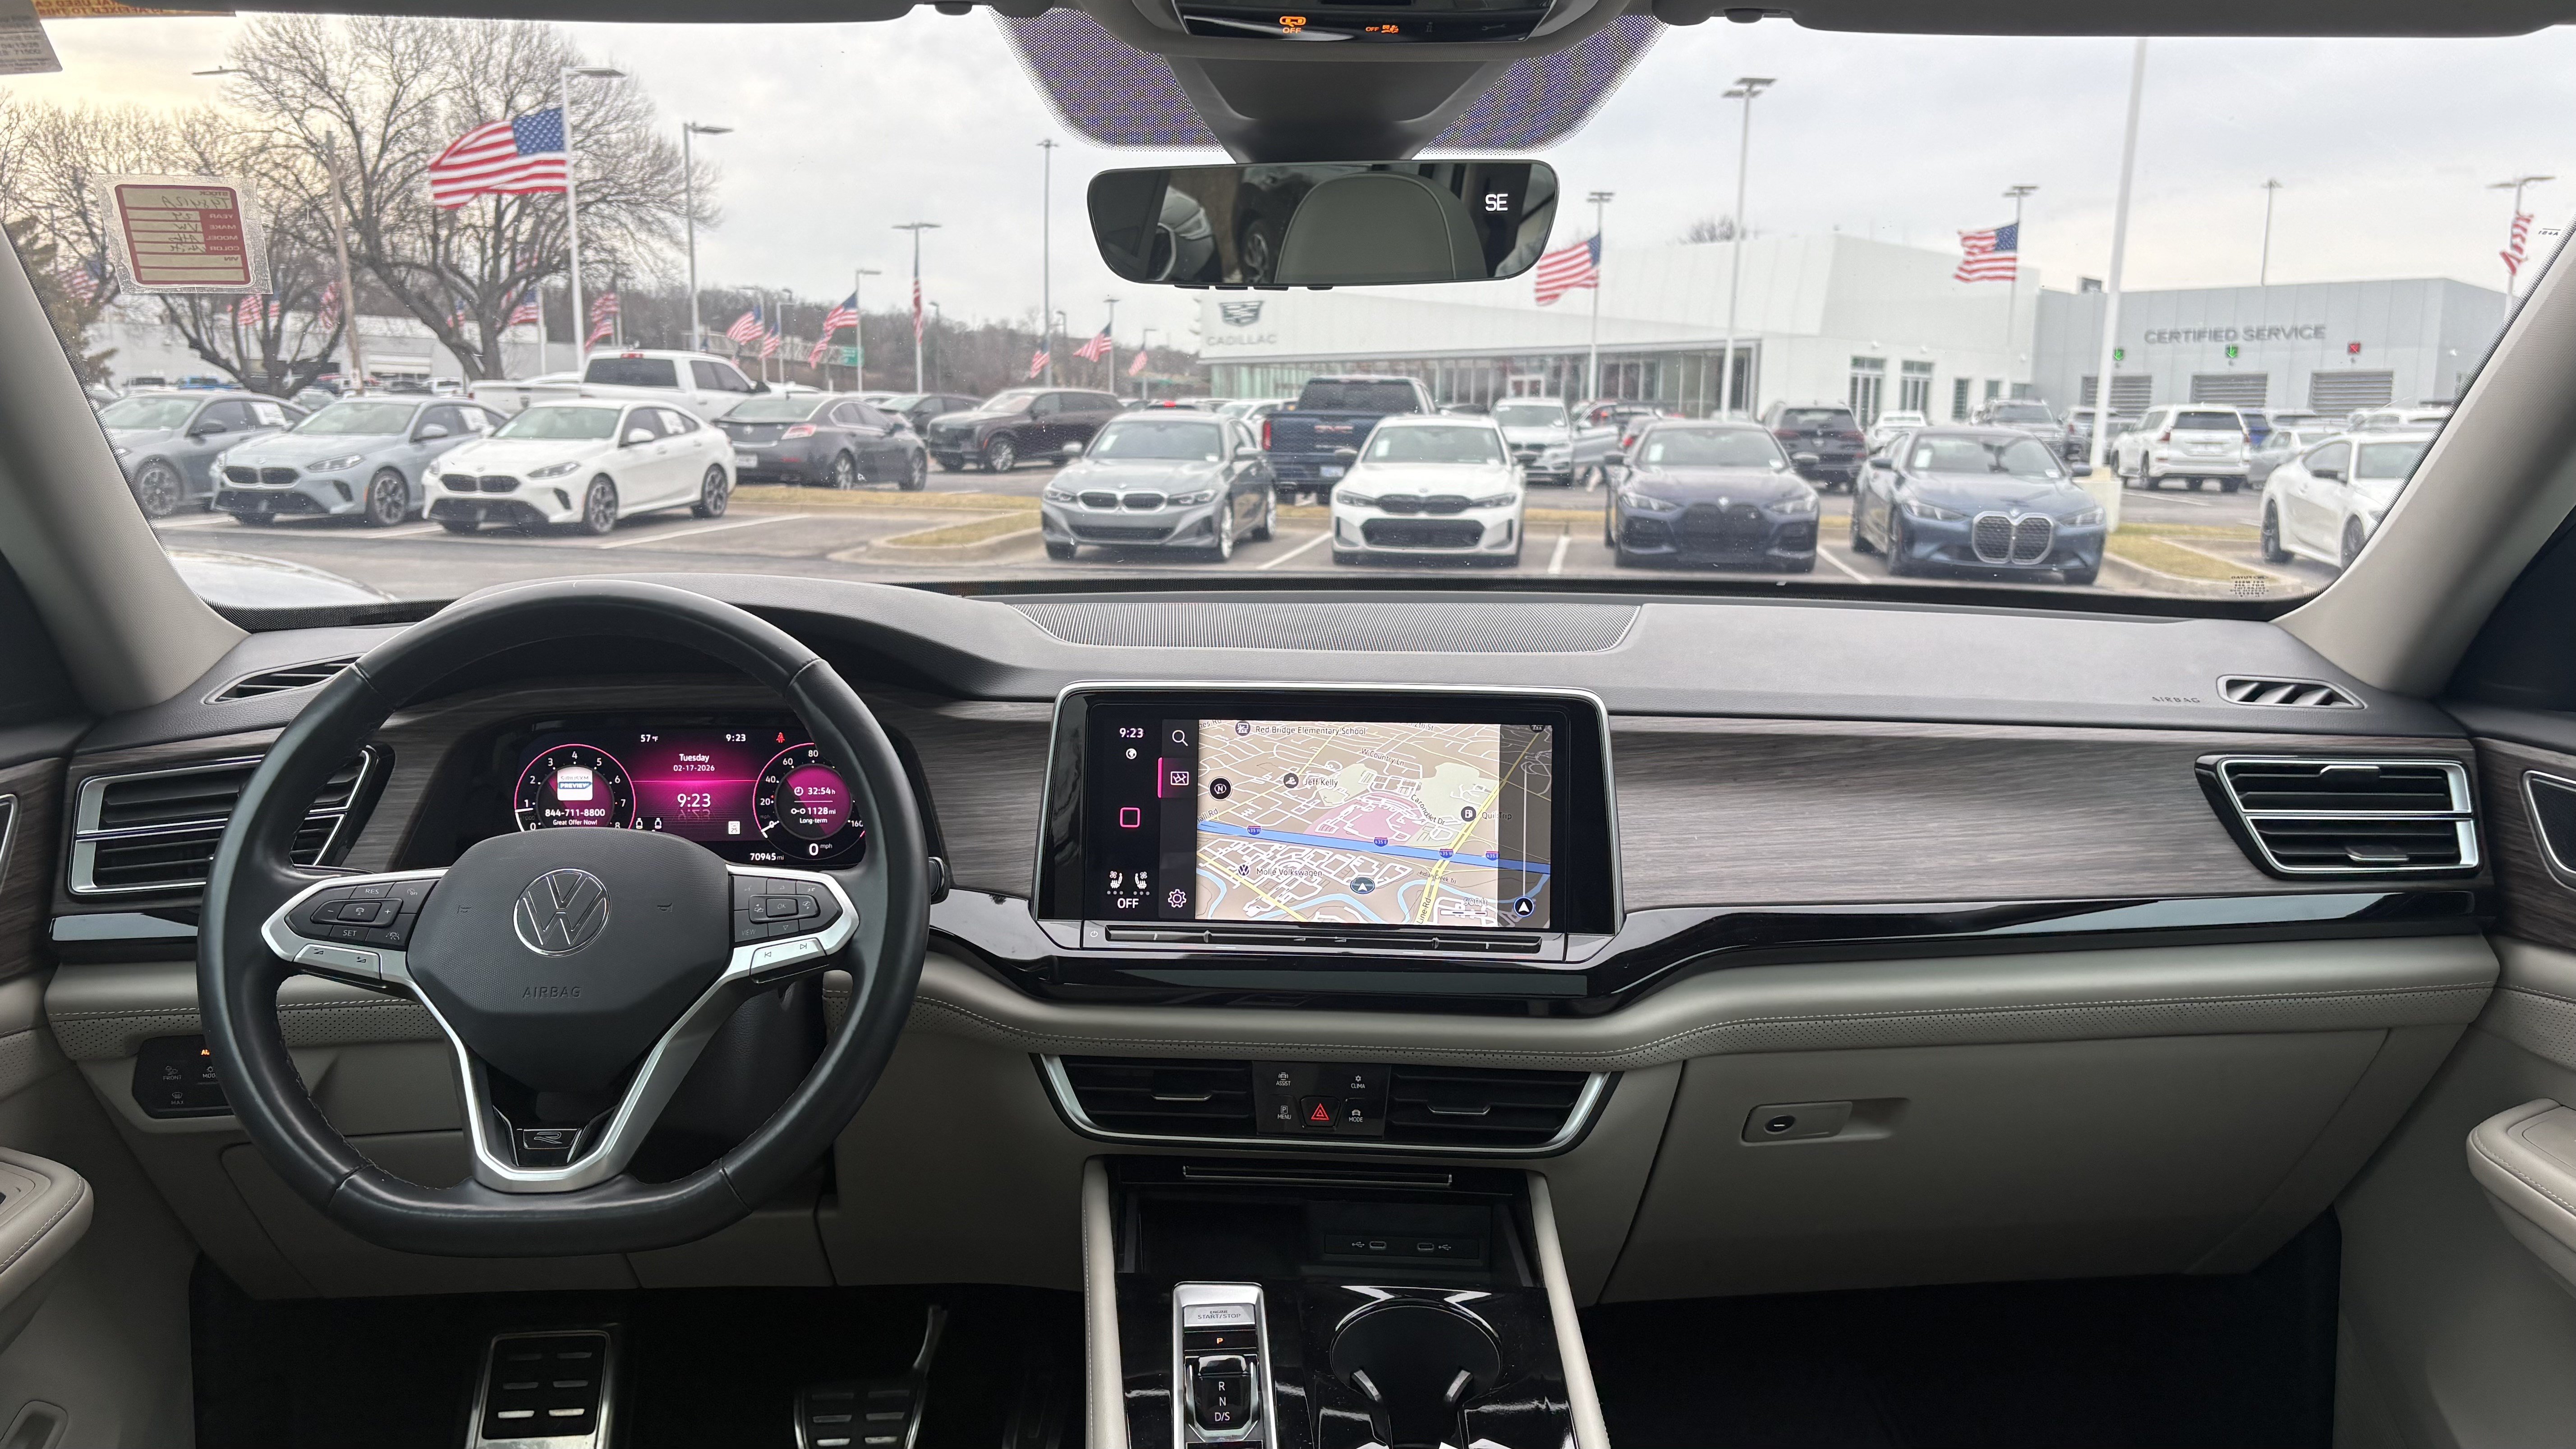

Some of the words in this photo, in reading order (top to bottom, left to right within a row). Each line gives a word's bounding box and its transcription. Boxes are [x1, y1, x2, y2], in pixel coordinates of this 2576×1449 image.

[1485, 193, 1508, 211] SE
[2144, 327, 2238, 345] CERTIFIED
[2242, 324, 2326, 342] SERVICE
[1206, 334, 1277, 346] CADILLAC
[1119, 728, 1144, 738] 9:23
[1272, 726, 1295, 735] Bridge
[1298, 727, 1339, 736] Elementary
[726, 734, 746, 742] 9:23
[548, 758, 553, 766] 3
[679, 754, 710, 762] Tuesday
[1370, 750, 1395, 764] Country
[1320, 779, 1338, 787] Kelly
[677, 793, 711, 808] 9:23
[760, 798, 770, 806] 20
[1208, 808, 1218, 817] Rd
[530, 823, 536, 831] 0
[809, 843, 819, 856] 0
[1279, 869, 1323, 878] Volkswagen
[1435, 874, 1449, 883] Creek
[1117, 898, 1139, 909] OFF
[1416, 908, 1428, 924] Line
[1422, 897, 1431, 908] Rd
[522, 986, 582, 998] AIRBAG
[1219, 1381, 1225, 1391] R
[1219, 1397, 1227, 1407] N
[1214, 1411, 1231, 1422] D/S
